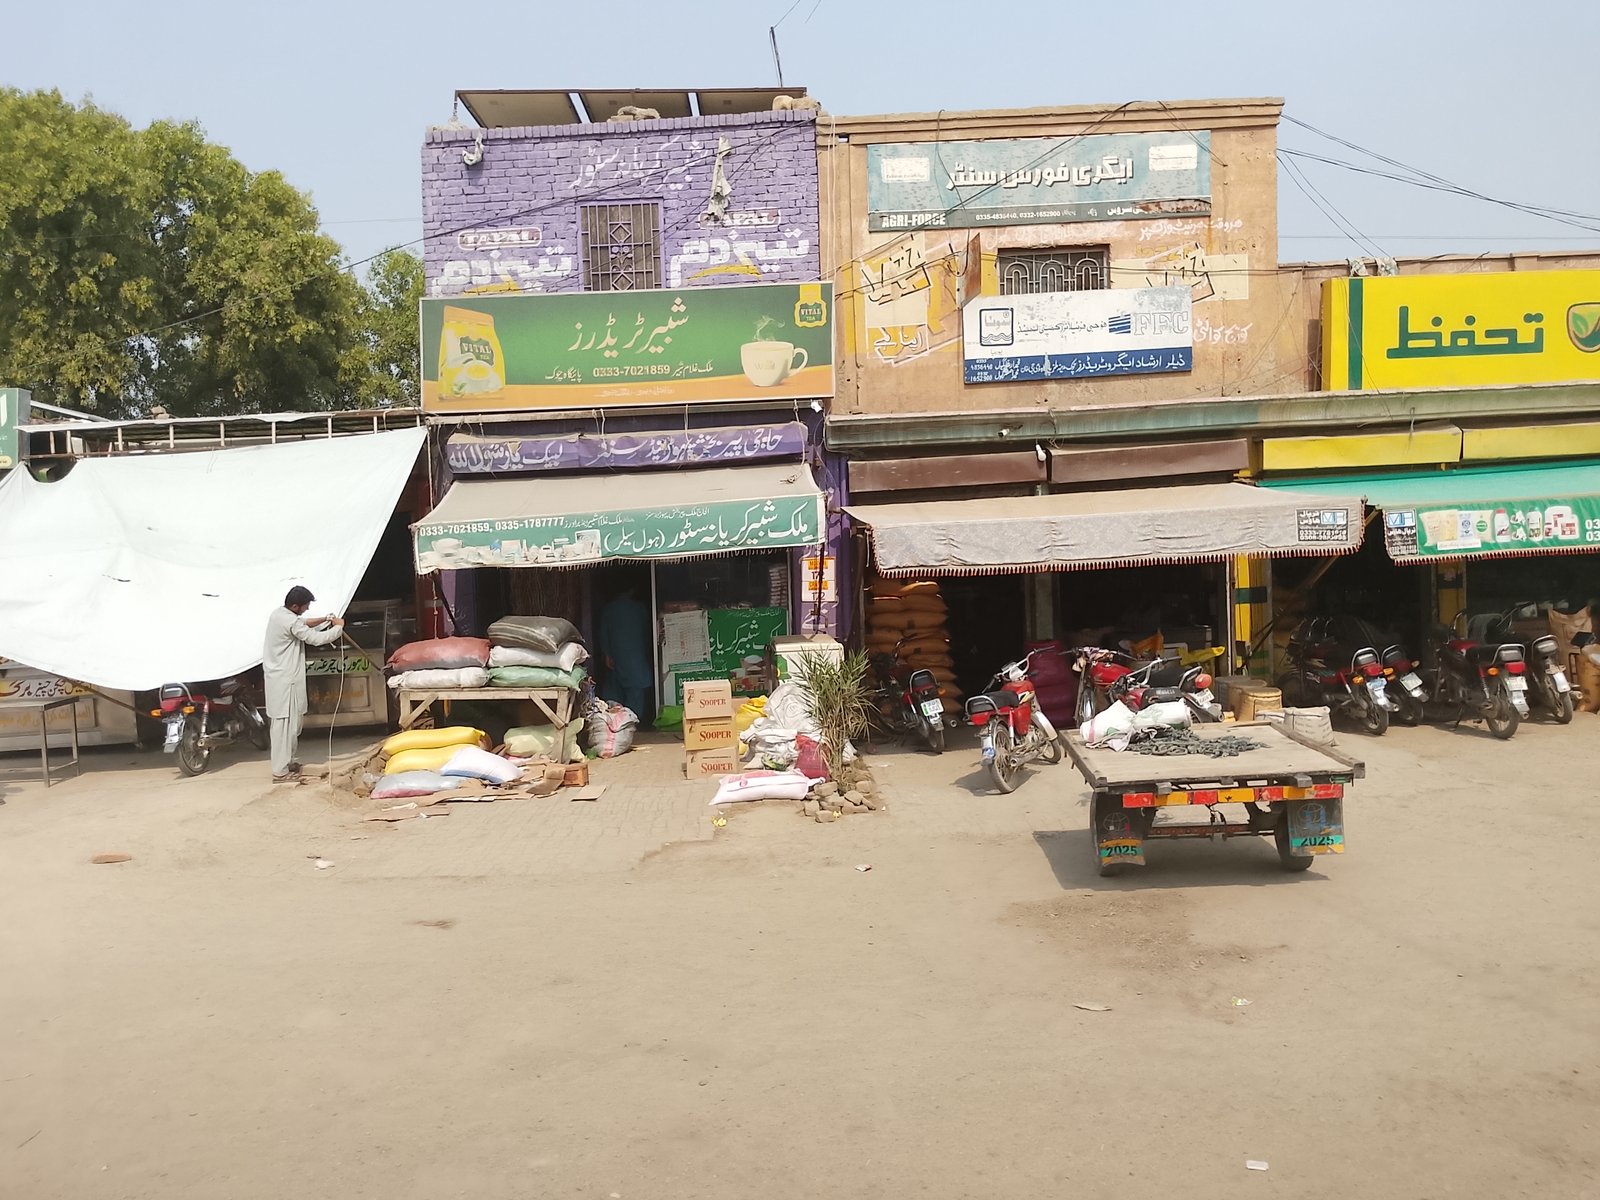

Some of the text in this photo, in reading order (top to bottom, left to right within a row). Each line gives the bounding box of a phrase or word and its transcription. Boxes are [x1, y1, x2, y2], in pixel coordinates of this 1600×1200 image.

[1003, 161, 1070, 190] فورس
[1070, 156, 1134, 188] ایگری
[882, 212, 946, 228] AGRI-FORCE
[636, 296, 690, 355] شبیر
[1133, 311, 1189, 336] FFC
[1386, 305, 1544, 360] تحفظ
[462, 342, 492, 354] VITAL
[592, 364, 671, 378] 0333-7021859
[1135, 354, 1162, 369] ارشاد
[420, 516, 565, 537] 0333-7021859, 0335-1787777
[740, 499, 778, 546] شبیر
[767, 501, 815, 542] ملک
[667, 517, 711, 549] سٹور
[699, 698, 727, 709] SOOPER
[700, 730, 732, 742] SOOPER
[701, 762, 733, 774] SOOPER
[1105, 845, 1138, 858] 2025
